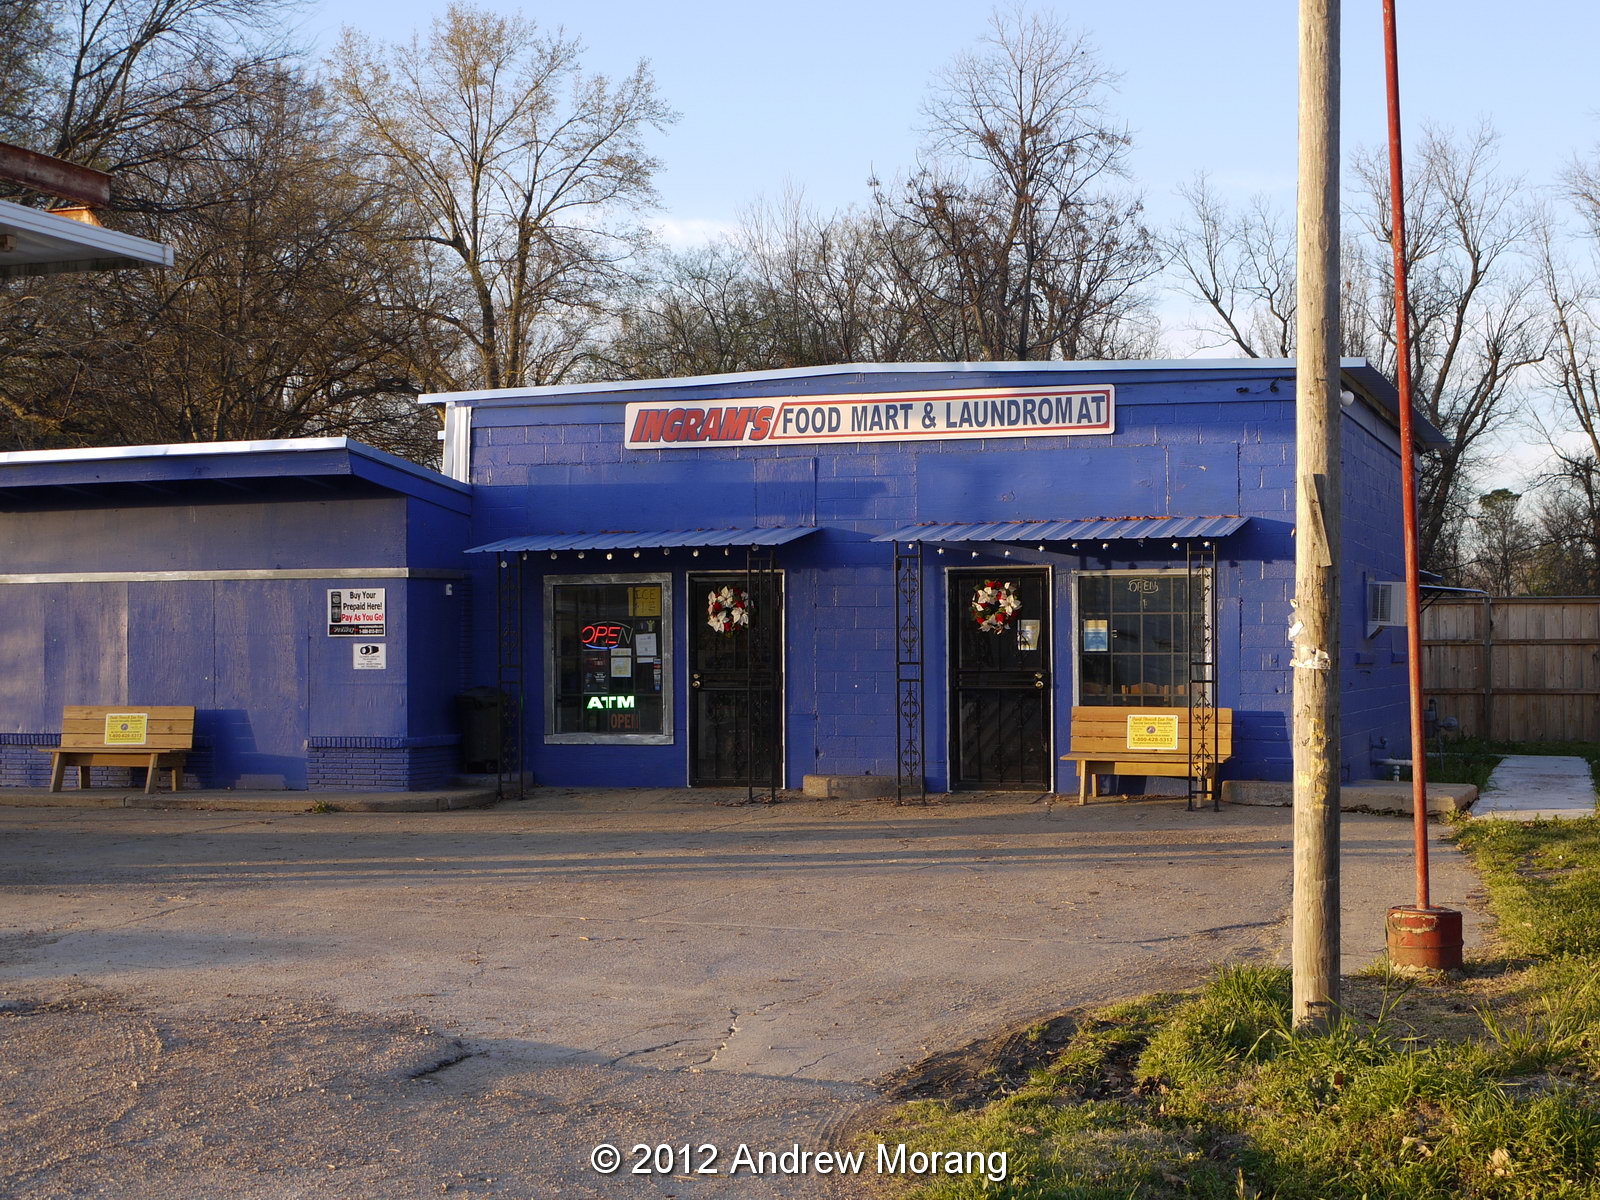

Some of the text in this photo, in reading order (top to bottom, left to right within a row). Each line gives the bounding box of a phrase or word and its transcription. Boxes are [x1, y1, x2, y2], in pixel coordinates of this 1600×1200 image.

[630, 395, 1106, 442] INGRAM'S FOOD MART & LAUNDROMAT
[349, 591, 376, 600] Buy Your
[343, 602, 383, 612] Prepaid Here!
[341, 613, 384, 623] Pay As You Go!
[582, 625, 634, 644] OPEN
[587, 695, 635, 709] ATM
